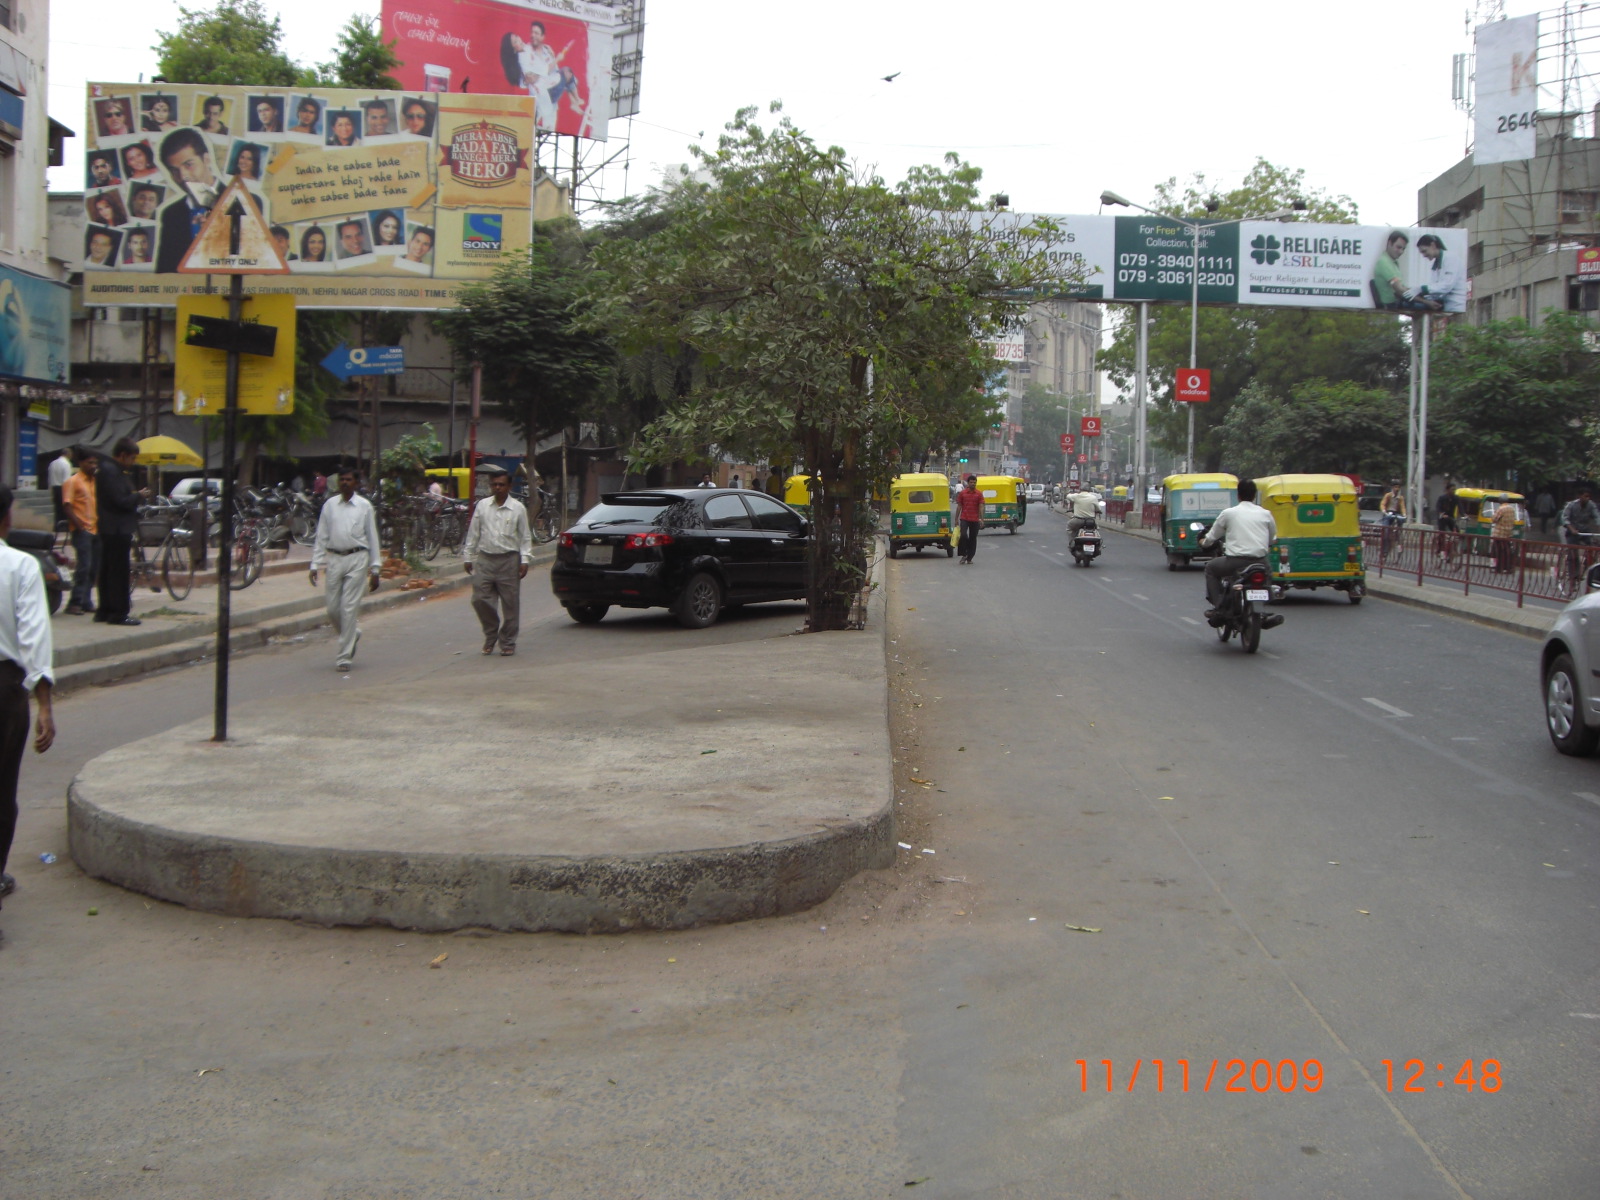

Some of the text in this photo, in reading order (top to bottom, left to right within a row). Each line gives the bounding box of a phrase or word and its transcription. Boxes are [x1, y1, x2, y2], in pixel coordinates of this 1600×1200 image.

[455, 132, 514, 144] MERA SABSE
[452, 142, 517, 155] BADA FAN
[452, 153, 516, 163] BANEGA MERA
[295, 157, 400, 175] India ke sabse bade
[458, 162, 509, 178] HERO
[278, 169, 421, 195] superstars khoj rahe hain
[320, 191, 349, 202] sabse
[353, 187, 378, 199] bade
[382, 185, 408, 196] fans
[1139, 224, 1155, 234] For
[462, 241, 500, 249] SONY
[1146, 237, 1189, 249] Collection,
[1120, 253, 1148, 266] 079
[1158, 255, 1194, 267] 3940
[1199, 257, 1232, 269] 1111
[1291, 255, 1323, 268] SRL
[1119, 270, 1147, 282] 079
[1157, 271, 1192, 283] 3061
[1198, 273, 1234, 286] 2200
[1250, 273, 1361, 285] Super Religare Laboratories
[91, 285, 134, 293] AUDITIONS
[139, 285, 160, 293] DATE
[163, 286, 179, 294] NOV
[221, 286, 256, 294] SHYAS
[312, 288, 339, 296] NEHRU
[341, 288, 367, 296] NAGAR
[370, 289, 395, 297] CROSS
[398, 289, 419, 297] ROAD
[425, 290, 446, 298] TIME
[1262, 286, 1296, 294] Trusted
[1300, 287, 1308, 295] by
